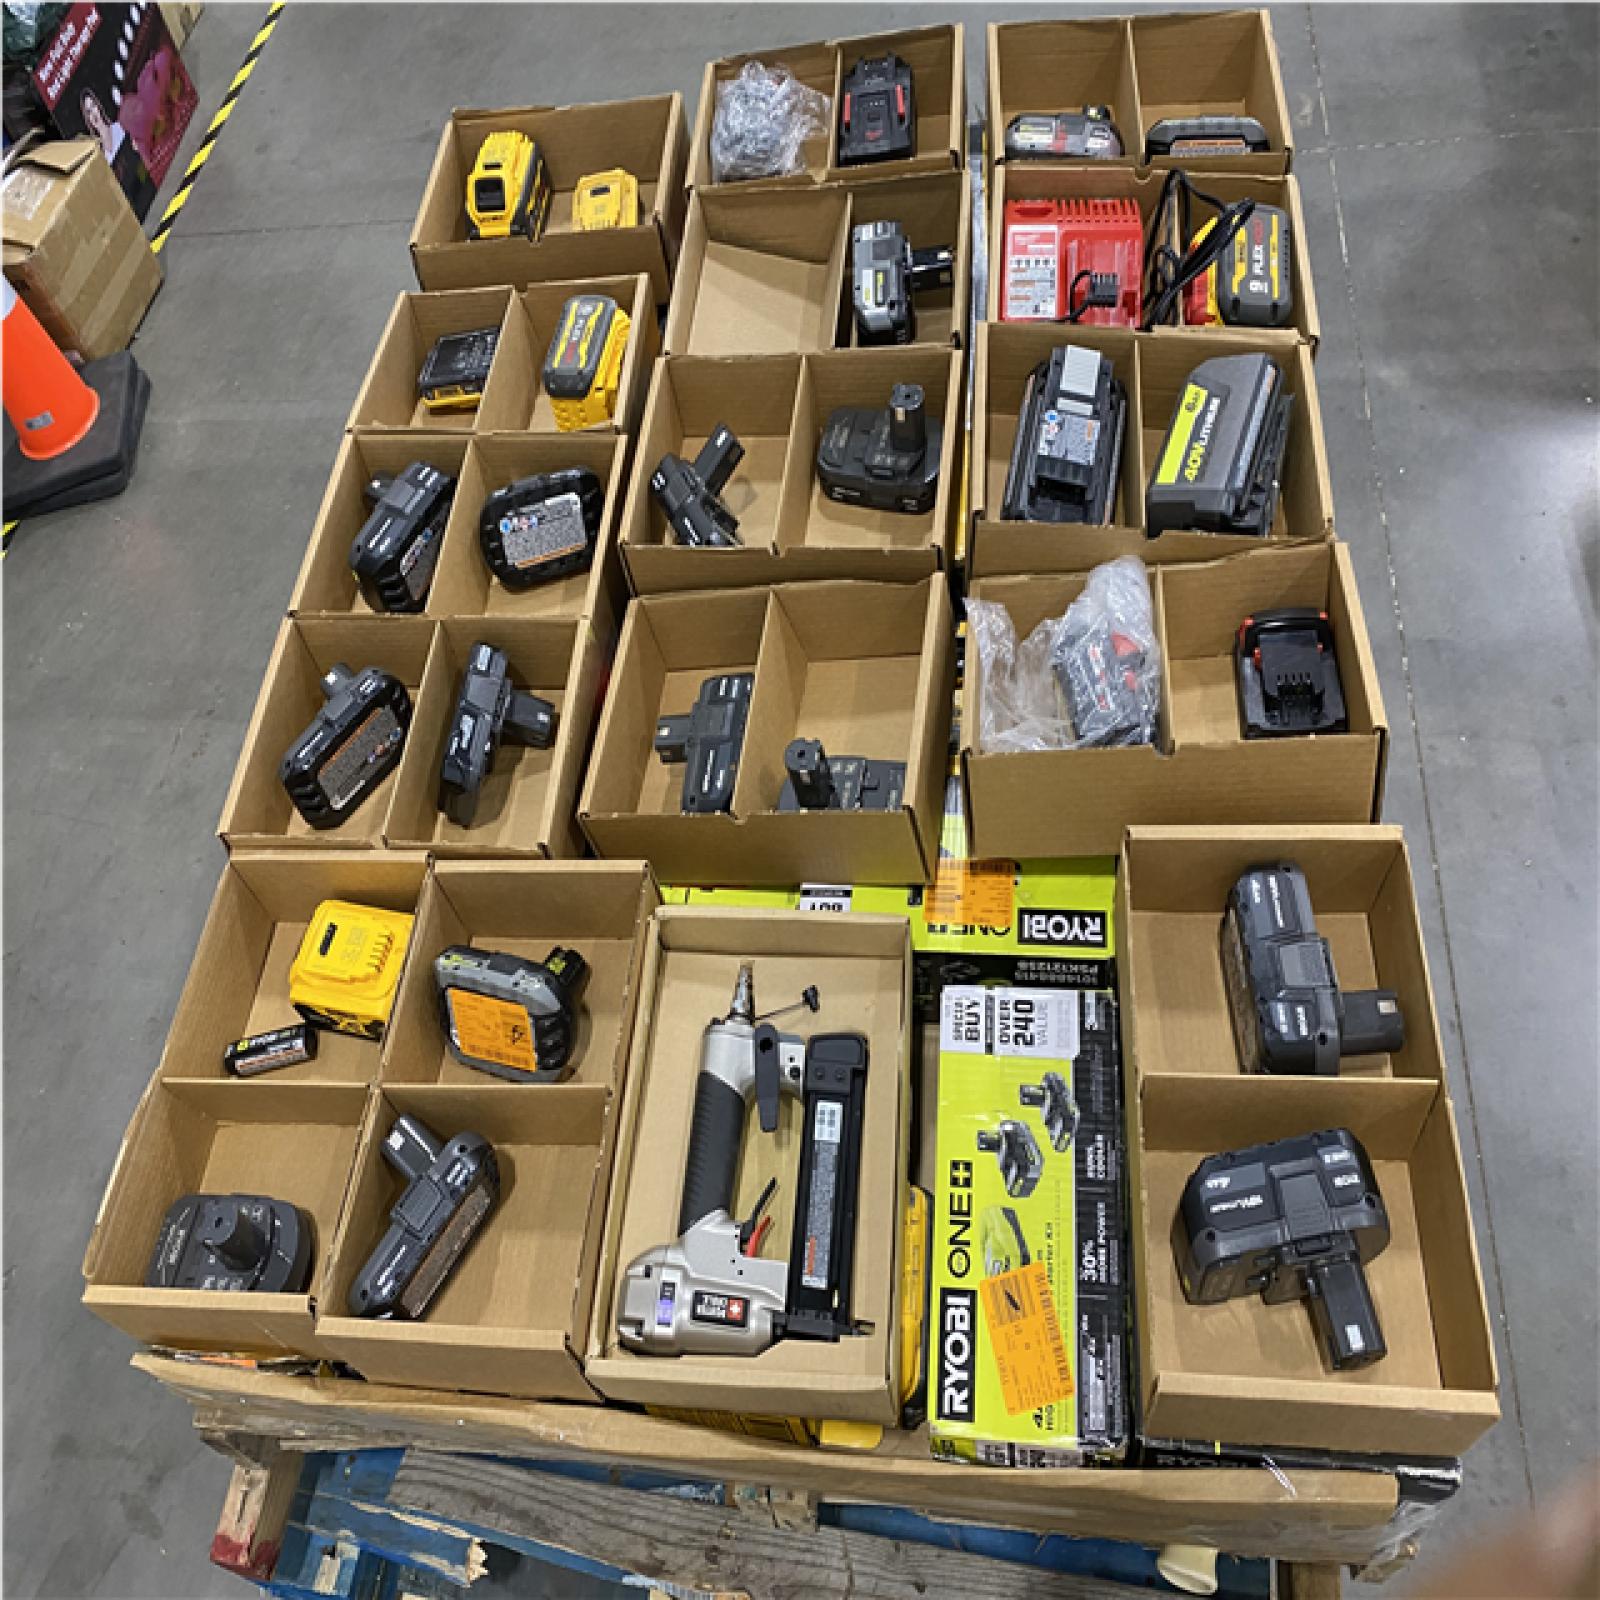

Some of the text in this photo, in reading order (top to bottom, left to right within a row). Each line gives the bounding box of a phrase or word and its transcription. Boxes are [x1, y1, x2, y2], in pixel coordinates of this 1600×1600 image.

[1021, 913, 1104, 942] RYOBI
[965, 1000, 980, 1042] BUY
[999, 999, 1011, 1044] OVER
[1014, 999, 1035, 1046] 240
[1096, 1201, 1106, 1246] POWER
[1081, 1239, 1097, 1282] 30%
[943, 1160, 973, 1415] RYOBI ONE+
